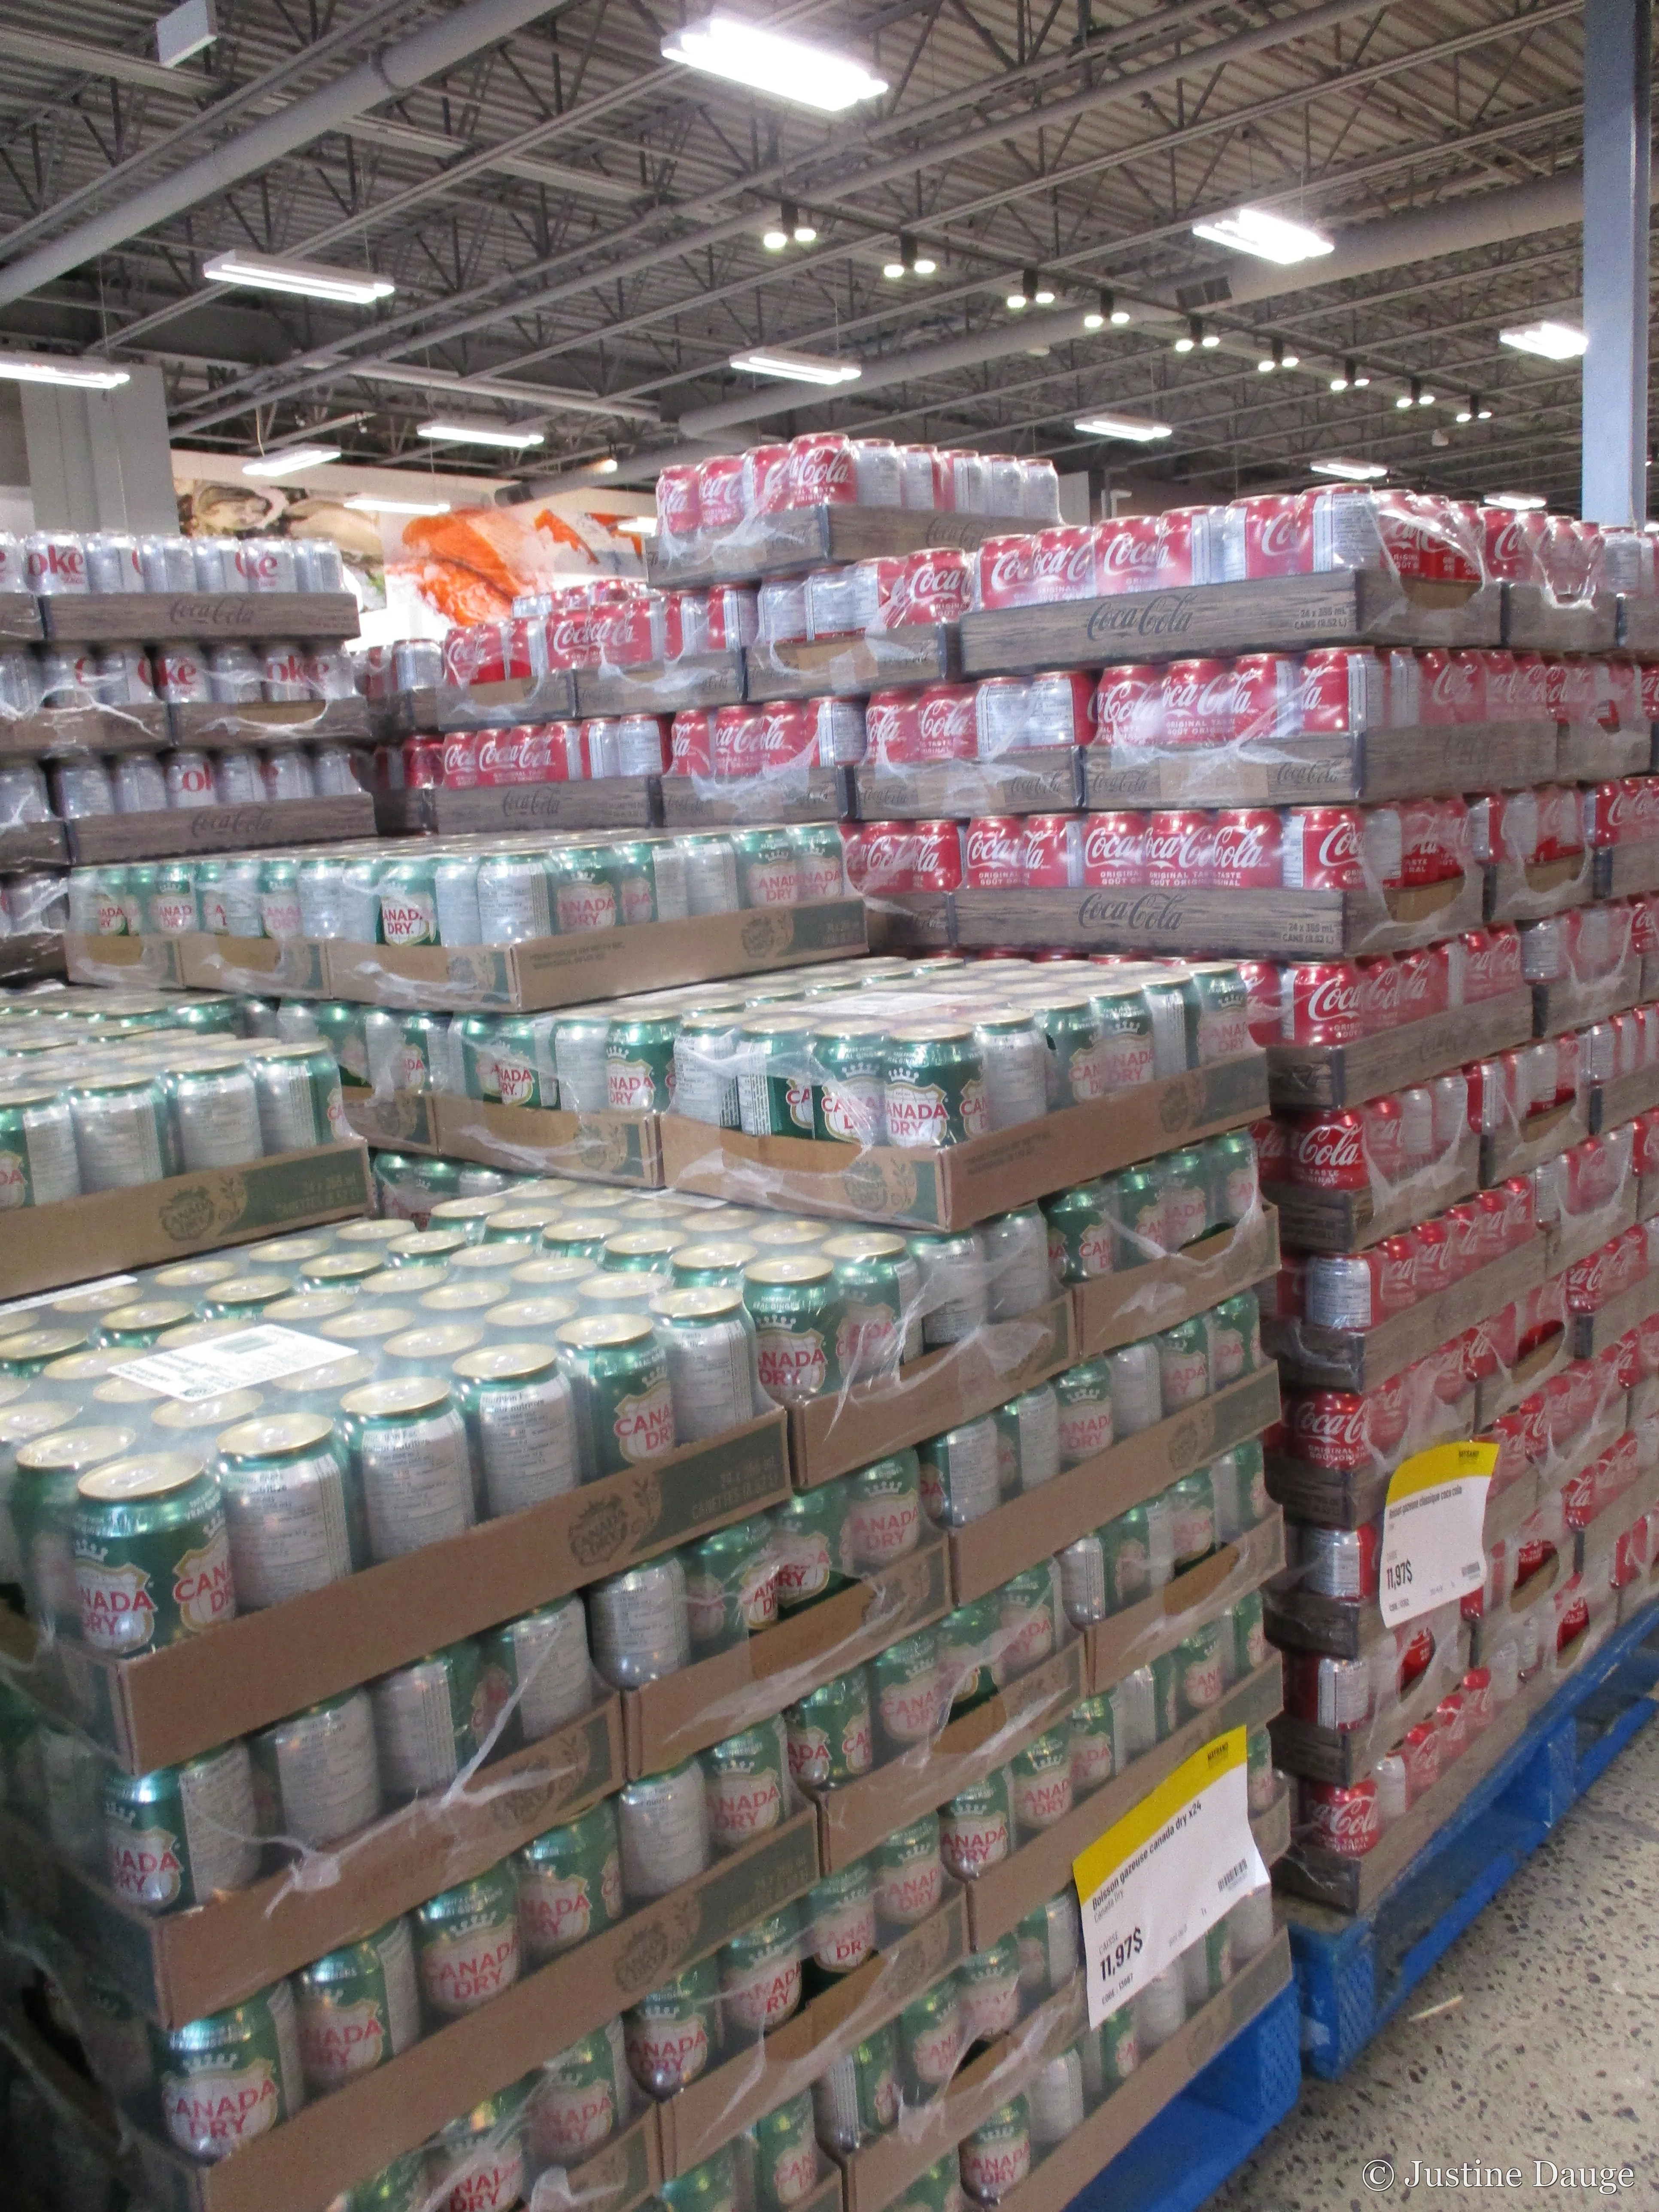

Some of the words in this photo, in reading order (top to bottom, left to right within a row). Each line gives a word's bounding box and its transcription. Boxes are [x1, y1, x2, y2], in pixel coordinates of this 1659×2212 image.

[28, 545, 83, 577] oke
[383, 908, 423, 921] ANAD
[609, 1076, 654, 1091] NADA
[886, 1099, 948, 1120] ANADA
[81, 1587, 155, 1613] NADA
[176, 2078, 276, 2116] ANADA
